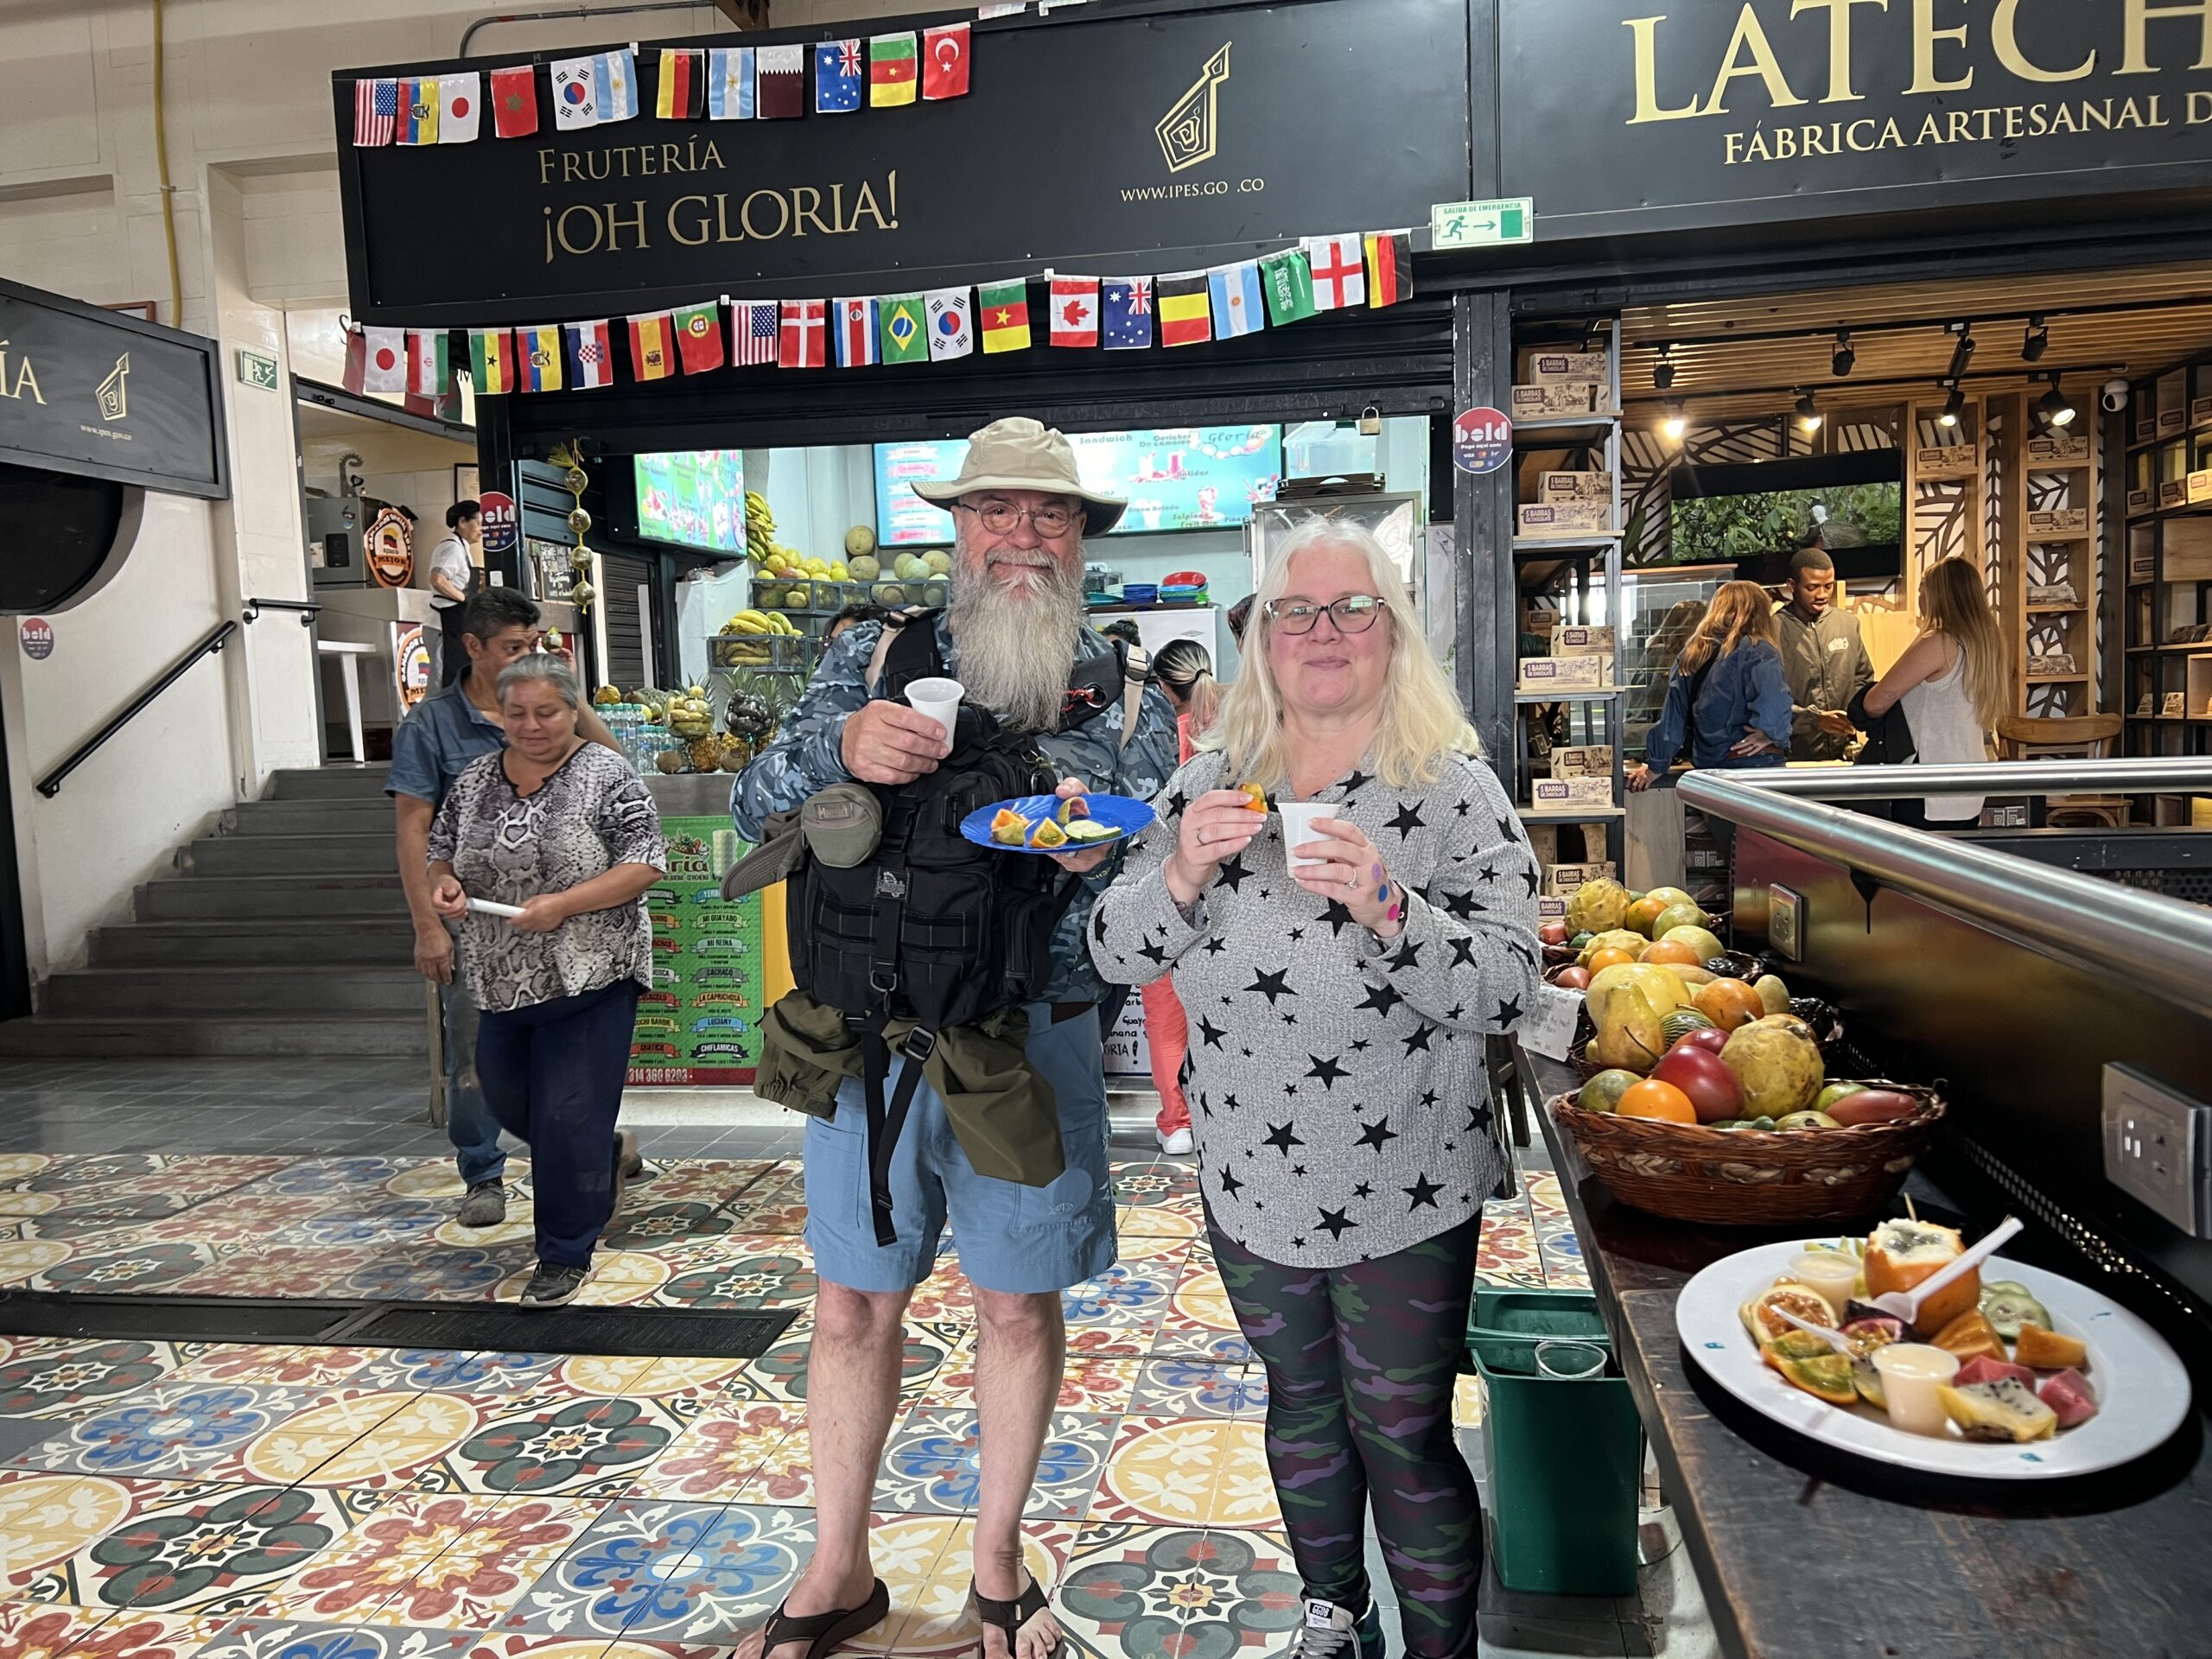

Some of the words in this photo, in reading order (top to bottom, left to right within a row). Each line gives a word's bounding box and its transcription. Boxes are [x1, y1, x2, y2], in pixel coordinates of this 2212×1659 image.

[1723, 120, 1909, 165] FÁBRICA
[1912, 95, 2171, 146] ARTESANAL
[1478, 202, 1522, 212] EMERGENCIA
[543, 200, 652, 264] ¡OH
[667, 169, 899, 245] GLORIA!
[1455, 421, 1507, 443] bold
[485, 505, 516, 524] old
[715, 938, 733, 947] REINA
[707, 993, 741, 1001] CAPRICHOSA
[700, 1044, 739, 1052] CHIFLAMICAS
